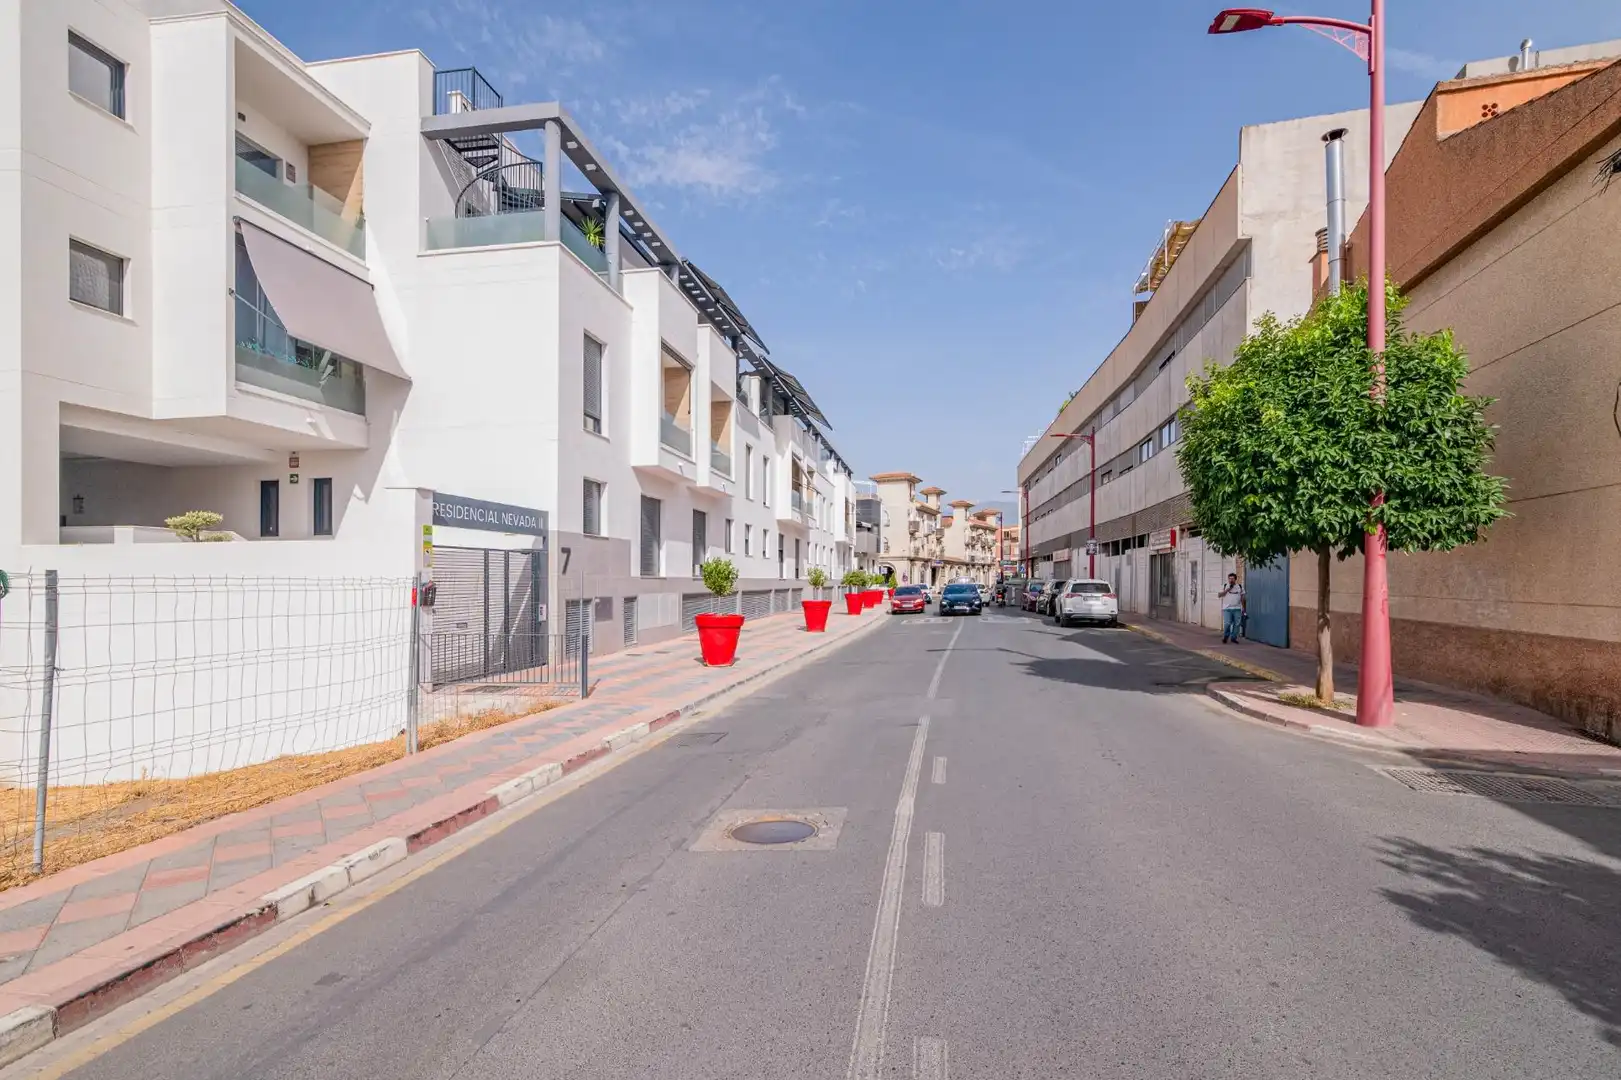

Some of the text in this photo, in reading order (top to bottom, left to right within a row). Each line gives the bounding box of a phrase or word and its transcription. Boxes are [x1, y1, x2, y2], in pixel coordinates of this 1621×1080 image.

[432, 502, 499, 524] RESIDENCIAL
[501, 513, 537, 528] NEVADA
[561, 547, 571, 576] 7
